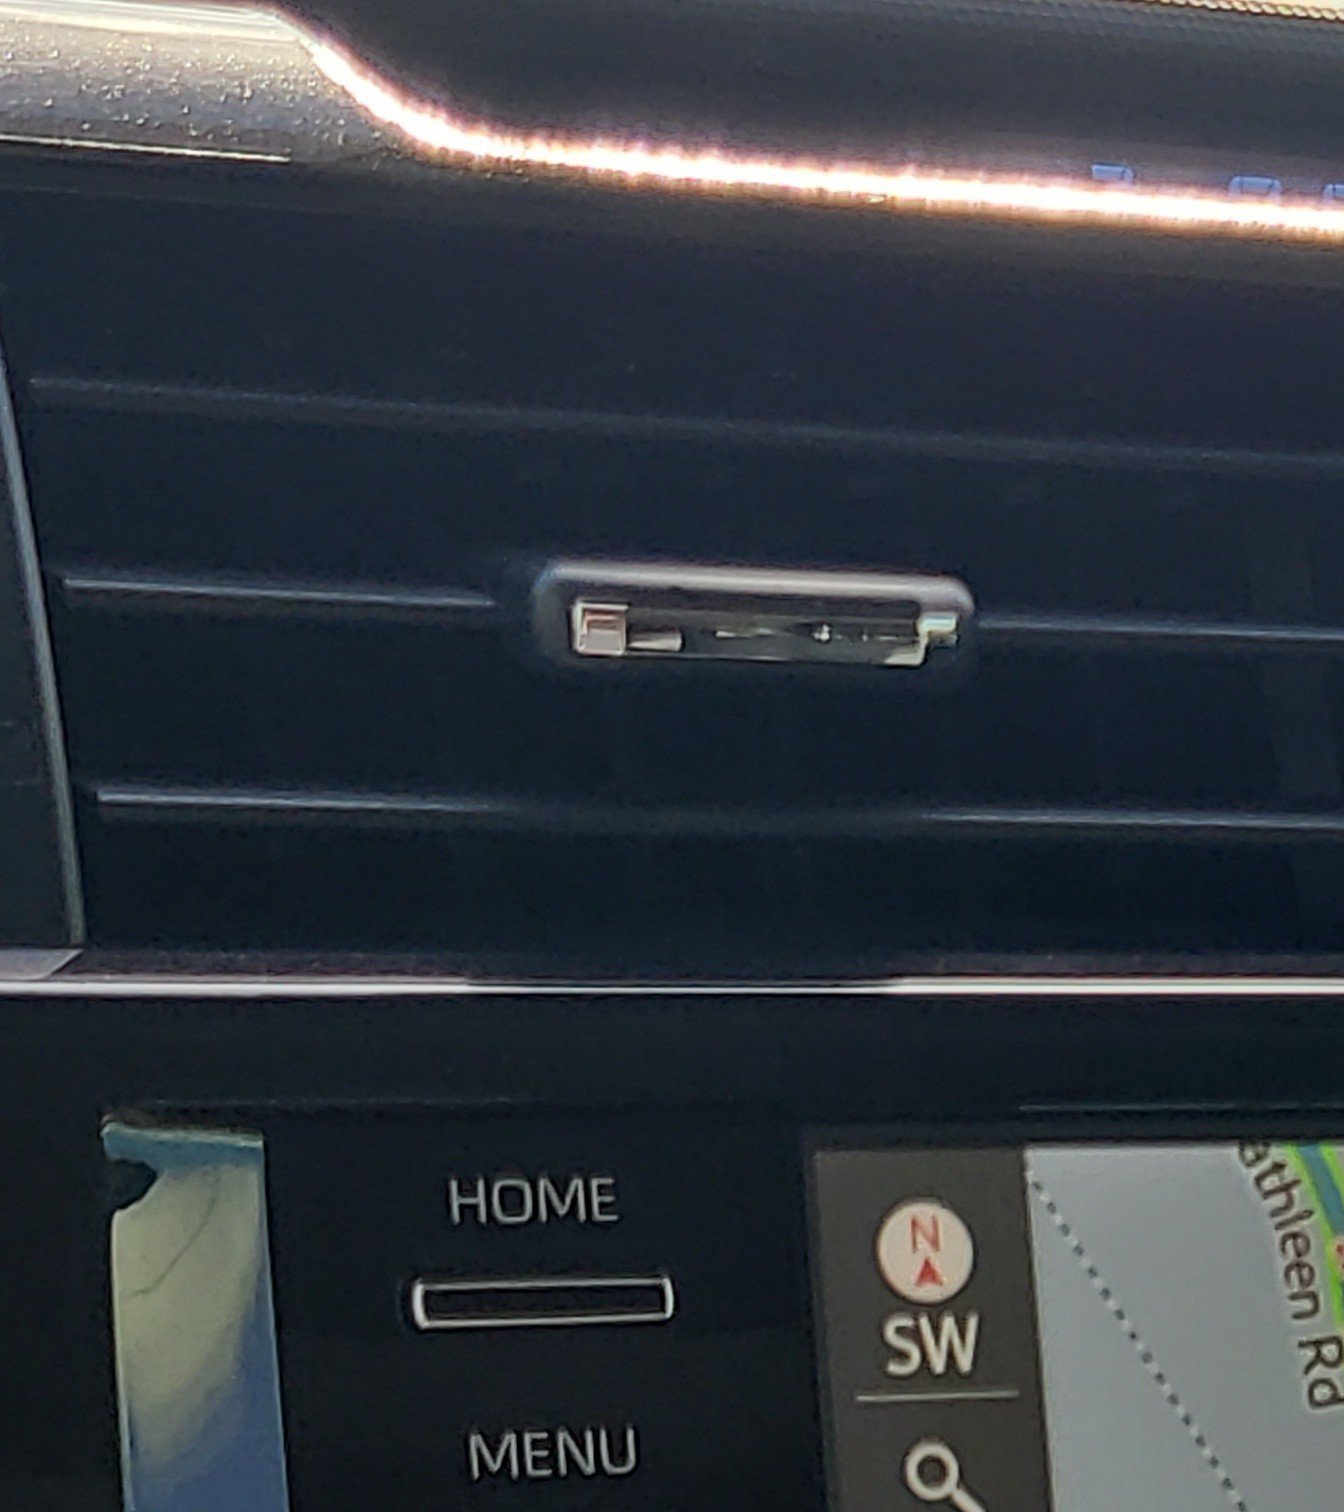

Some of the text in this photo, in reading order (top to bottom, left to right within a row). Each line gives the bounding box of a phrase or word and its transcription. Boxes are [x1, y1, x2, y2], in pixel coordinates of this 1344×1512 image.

[447, 1175, 620, 1225] HOME
[911, 1215, 942, 1253] N
[882, 1311, 980, 1376] SW
[468, 1426, 638, 1480] MENU
